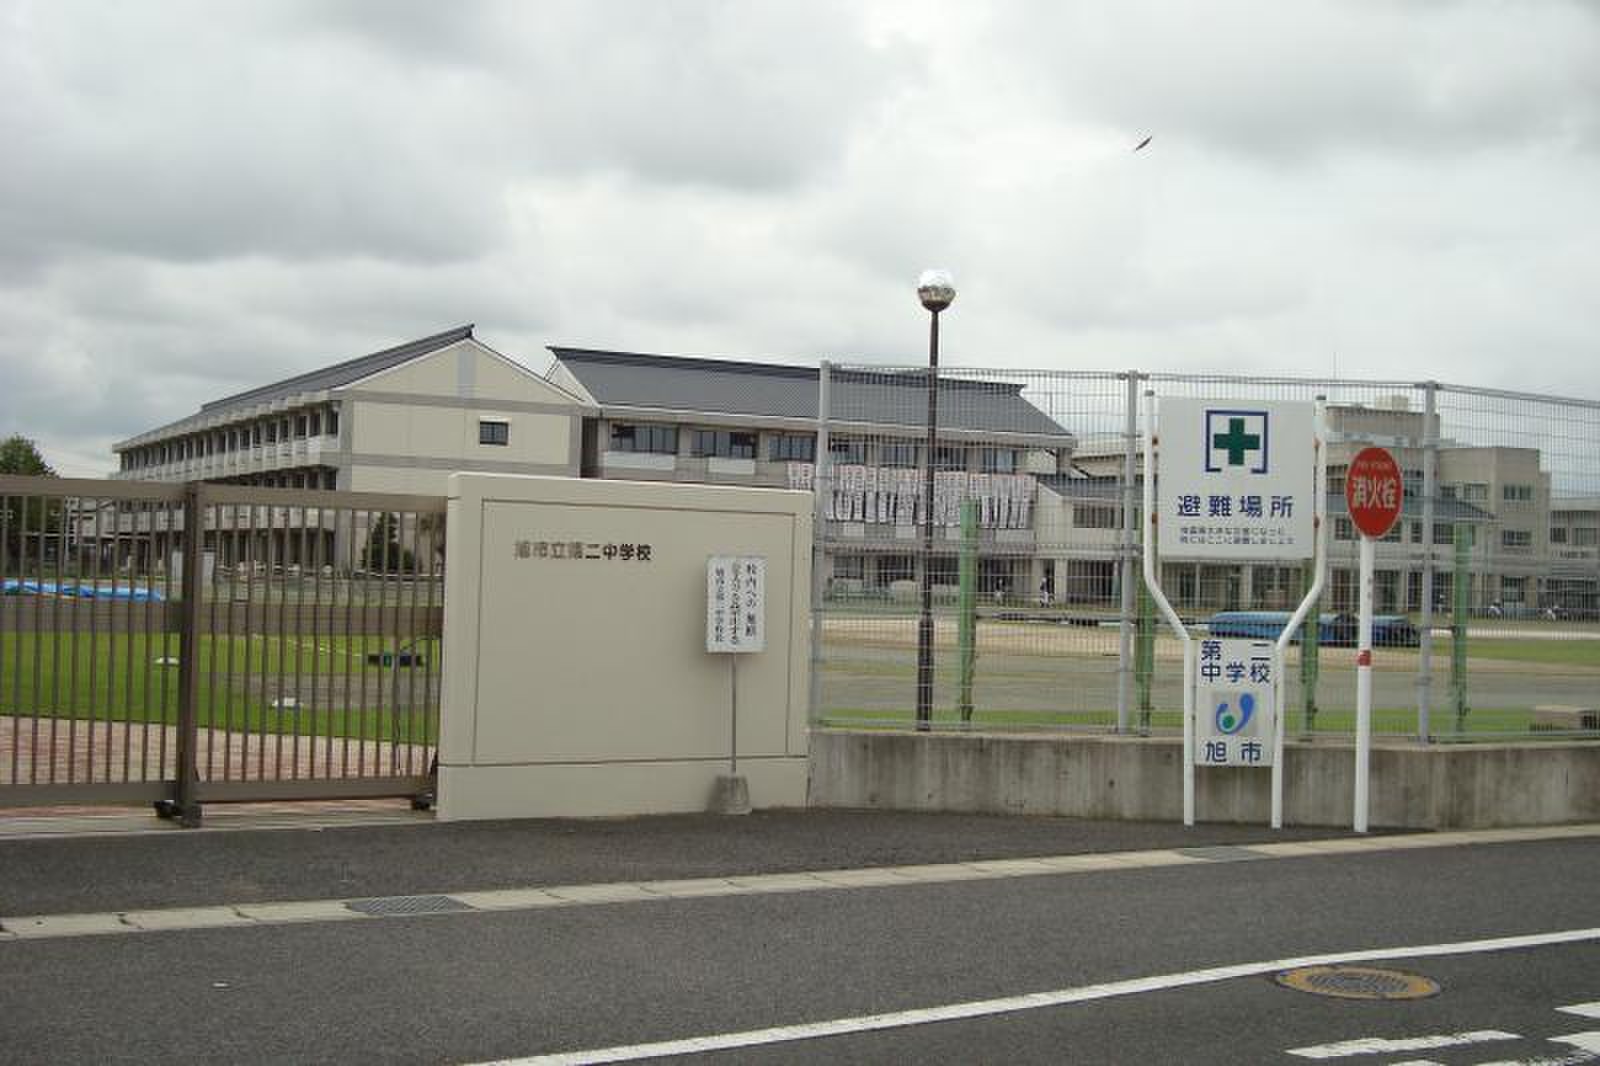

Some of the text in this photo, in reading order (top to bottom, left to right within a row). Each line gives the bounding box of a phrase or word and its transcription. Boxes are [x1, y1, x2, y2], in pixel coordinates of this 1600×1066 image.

[1352, 476, 1397, 510] 消火栓
[1177, 495, 1294, 518] 避難場所
[1201, 640, 1271, 661] 第二
[1201, 661, 1271, 684] 中学校
[1205, 741, 1263, 764] 旭市
